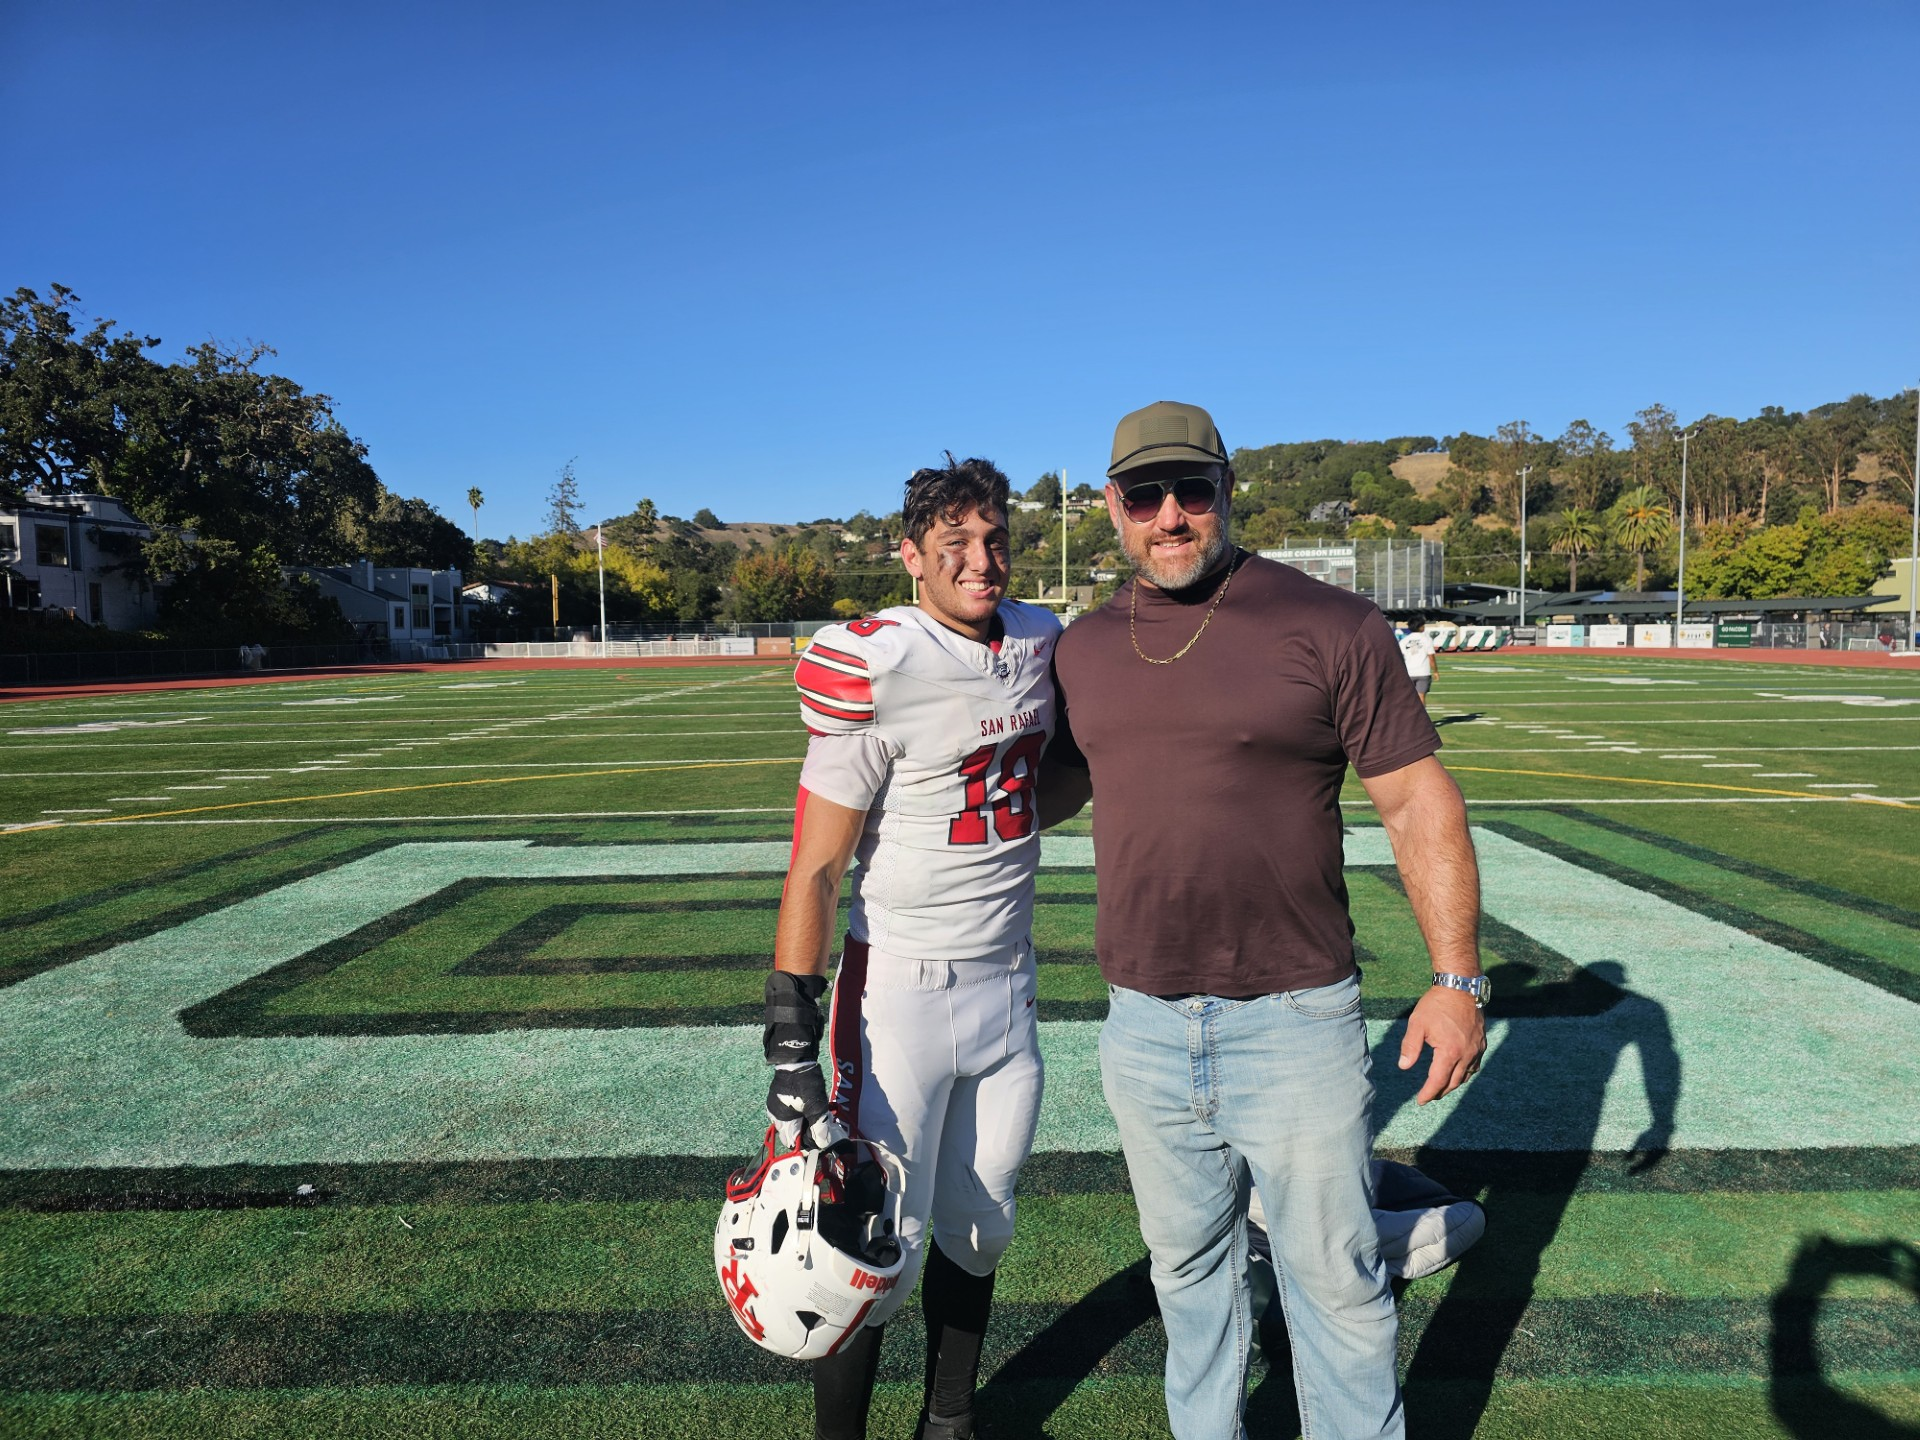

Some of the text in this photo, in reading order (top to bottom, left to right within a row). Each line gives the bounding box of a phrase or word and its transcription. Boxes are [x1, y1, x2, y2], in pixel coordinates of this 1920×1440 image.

[1261, 548, 1353, 559] GEORGE CORSON FIELD
[1330, 559, 1354, 567] VISITOR
[980, 708, 1041, 737] SAN RAFAEL
[947, 729, 1047, 845] 18
[834, 1057, 854, 1112] SAN
